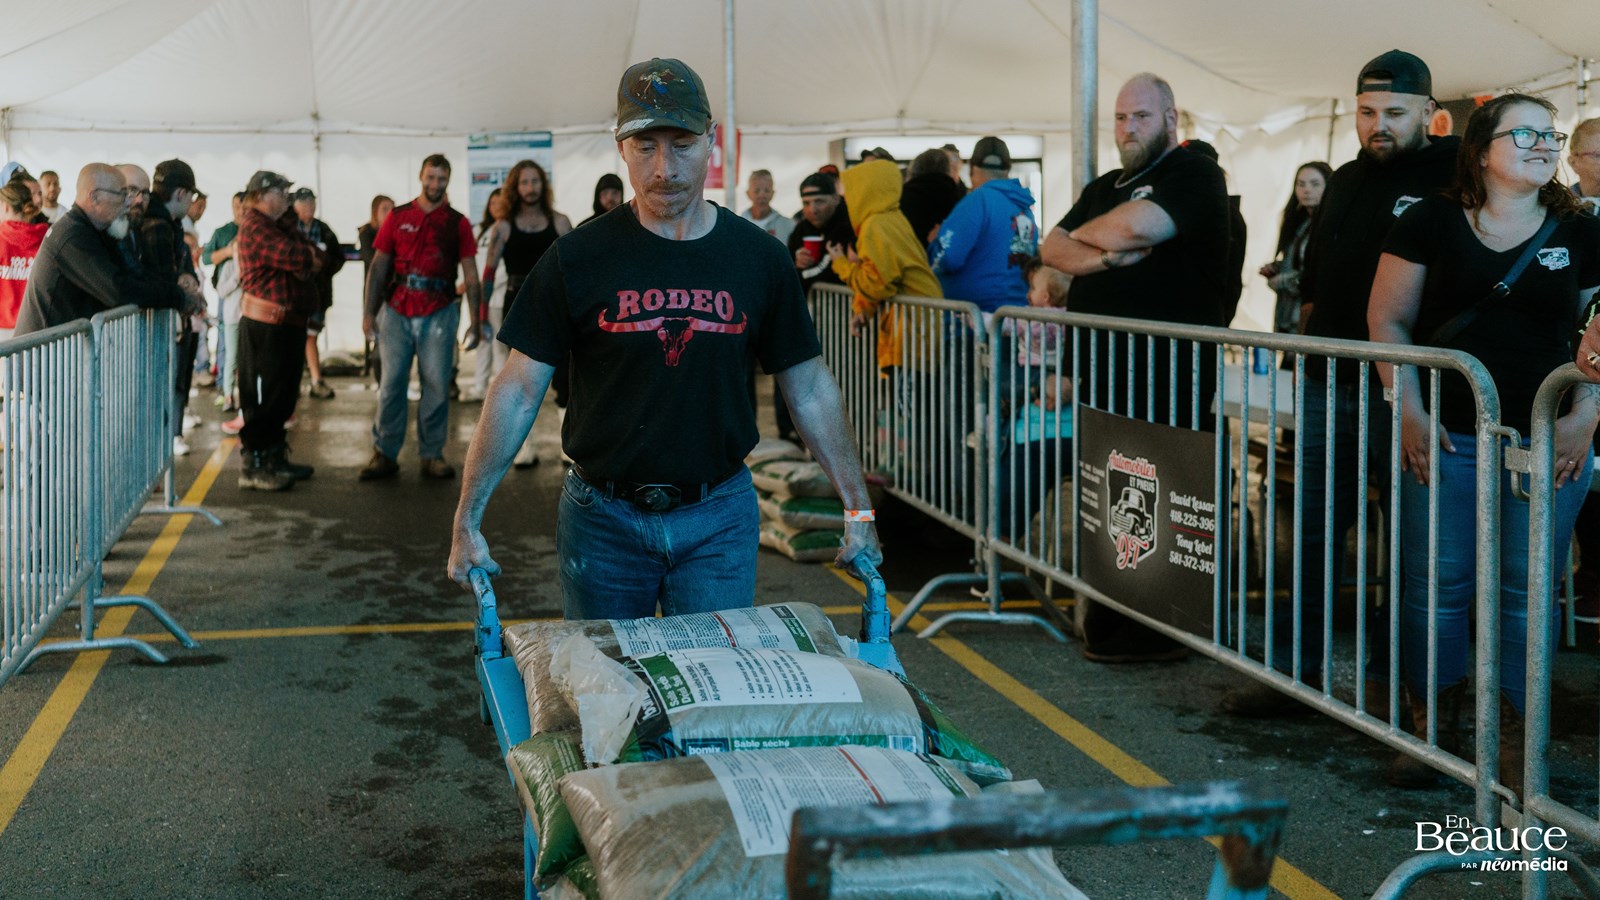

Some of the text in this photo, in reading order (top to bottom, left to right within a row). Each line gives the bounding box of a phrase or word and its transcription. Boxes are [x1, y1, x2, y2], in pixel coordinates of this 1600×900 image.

[616, 288, 735, 321] RODEO
[1109, 449, 1156, 480] Automobiles
[1129, 476, 1155, 493] ET PNEUS
[1169, 490, 1216, 513] David Lessar
[1170, 509, 1216, 532] 418-225-396
[1175, 533, 1212, 556] Tony Lebel
[1169, 551, 1216, 575] 581-372-343
[688, 745, 721, 756] bomix
[733, 740, 761, 749] Sable
